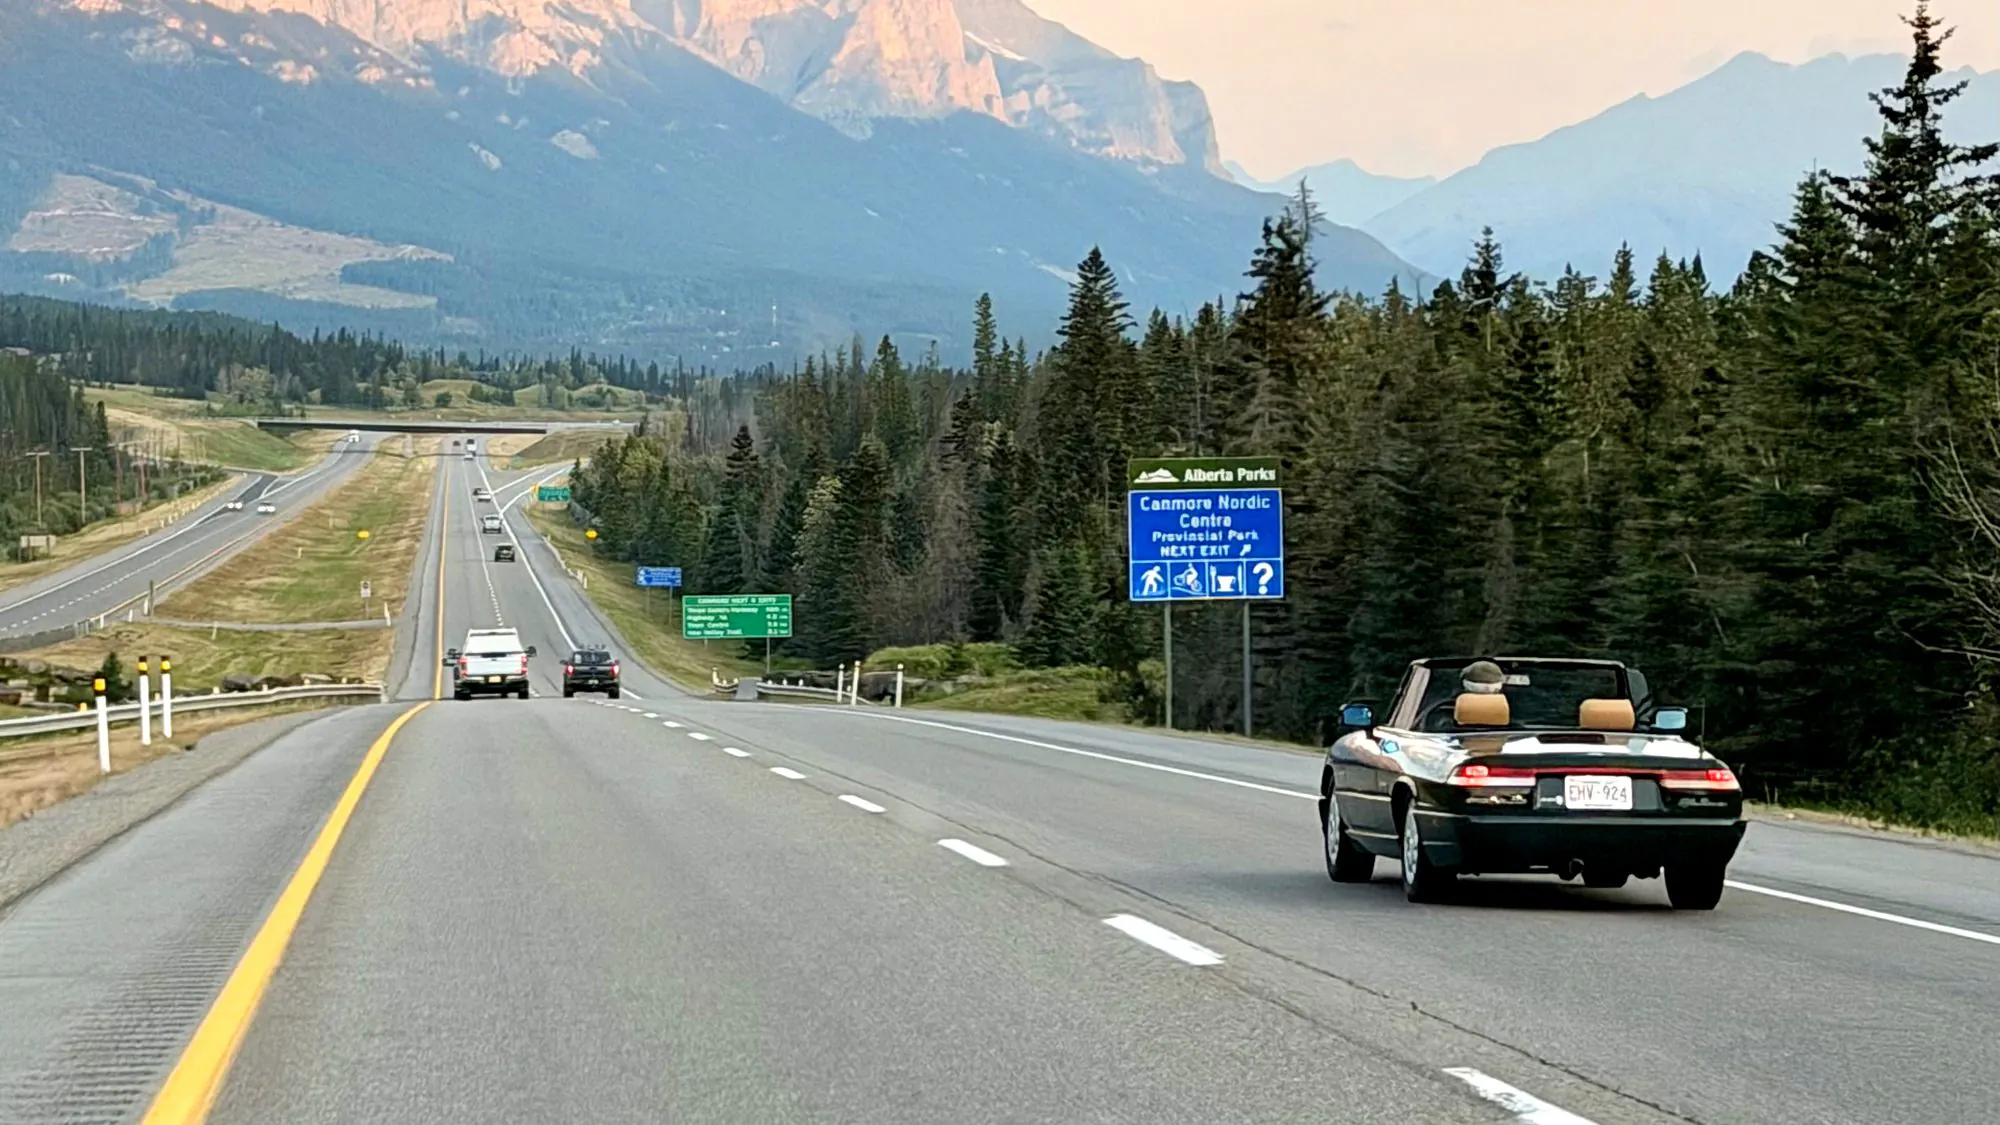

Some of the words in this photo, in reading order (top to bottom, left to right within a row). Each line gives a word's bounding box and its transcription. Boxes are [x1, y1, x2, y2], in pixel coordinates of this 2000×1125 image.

[1183, 468, 1233, 482] Alberta
[1237, 467, 1276, 481] Parks
[1140, 496, 1212, 511] Canmore
[1218, 494, 1271, 509] Nordic
[1179, 513, 1232, 528] Centre
[1152, 531, 1223, 542] Provincial
[1228, 530, 1259, 541] Park
[1160, 545, 1195, 557] NEXT
[1200, 545, 1231, 556] EXIT
